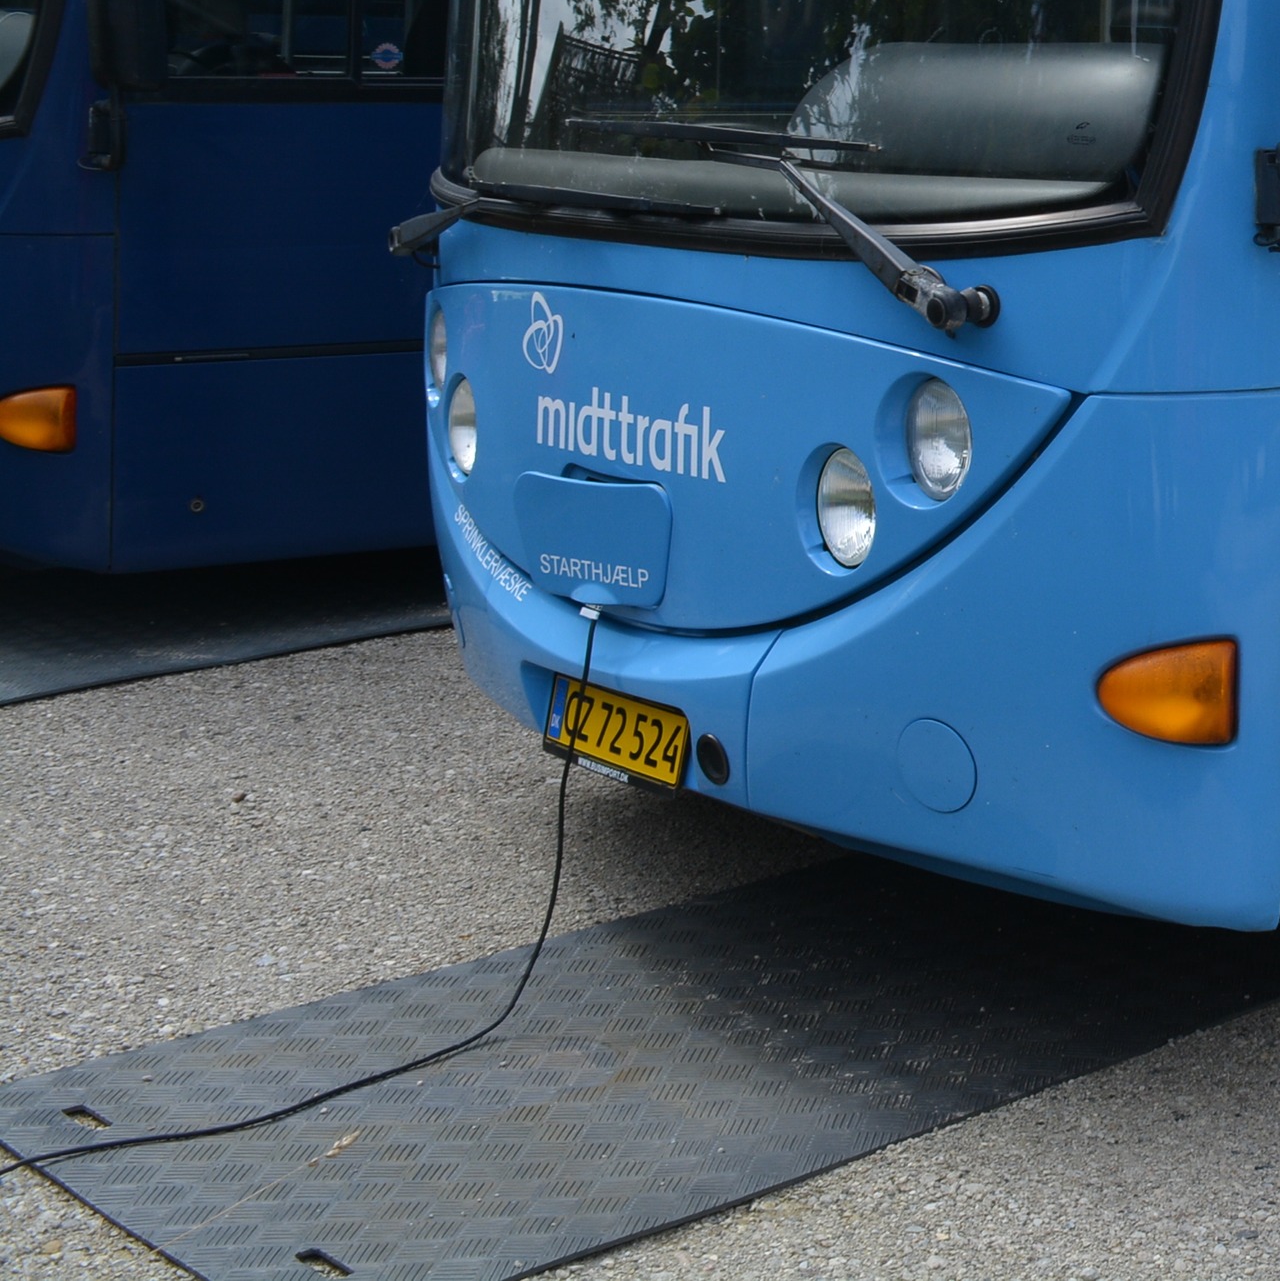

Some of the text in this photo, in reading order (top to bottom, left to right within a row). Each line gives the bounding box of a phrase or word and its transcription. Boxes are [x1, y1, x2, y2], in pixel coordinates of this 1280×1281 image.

[536, 386, 727, 483] midttrafik
[454, 504, 533, 603] SPRINKLERVÆSKE
[540, 553, 649, 589] STARTHJÆLP
[551, 713, 560, 729] DK
